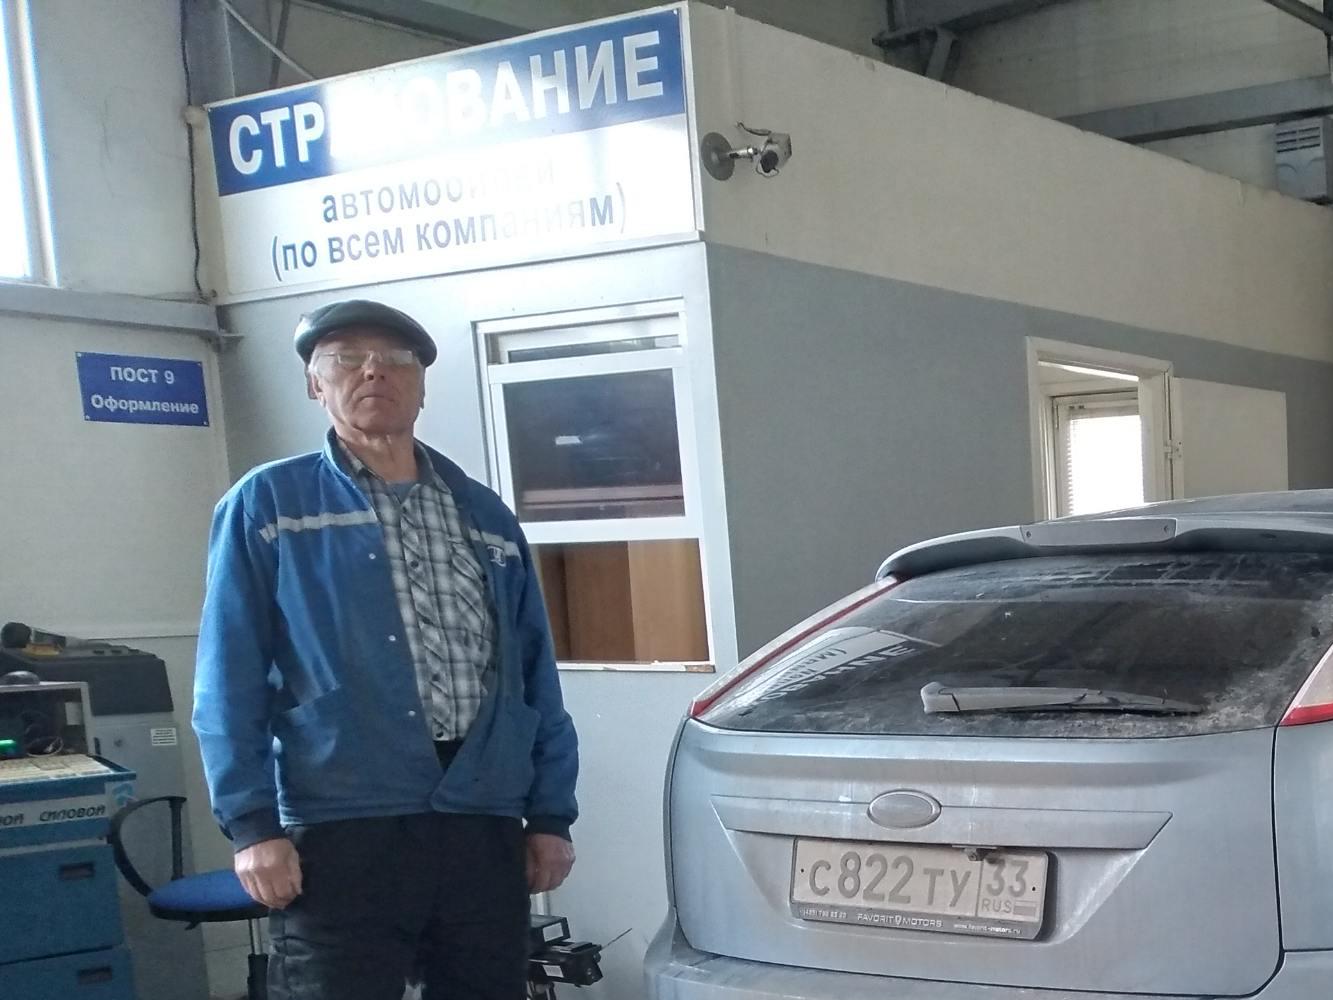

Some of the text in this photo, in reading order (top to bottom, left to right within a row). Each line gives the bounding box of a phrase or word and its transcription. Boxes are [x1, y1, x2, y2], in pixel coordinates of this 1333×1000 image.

[229, 30, 664, 175] СТРОВАНИЕ
[272, 235, 318, 282] (по
[327, 225, 405, 265] всем
[110, 366, 175, 385] ПОСТ 9
[90, 394, 200, 414] Оформление
[985, 856, 1030, 898] 33
[981, 898, 1013, 914] RUS
[857, 913, 894, 924] FAVORIT
[902, 917, 943, 928] MOTORS
